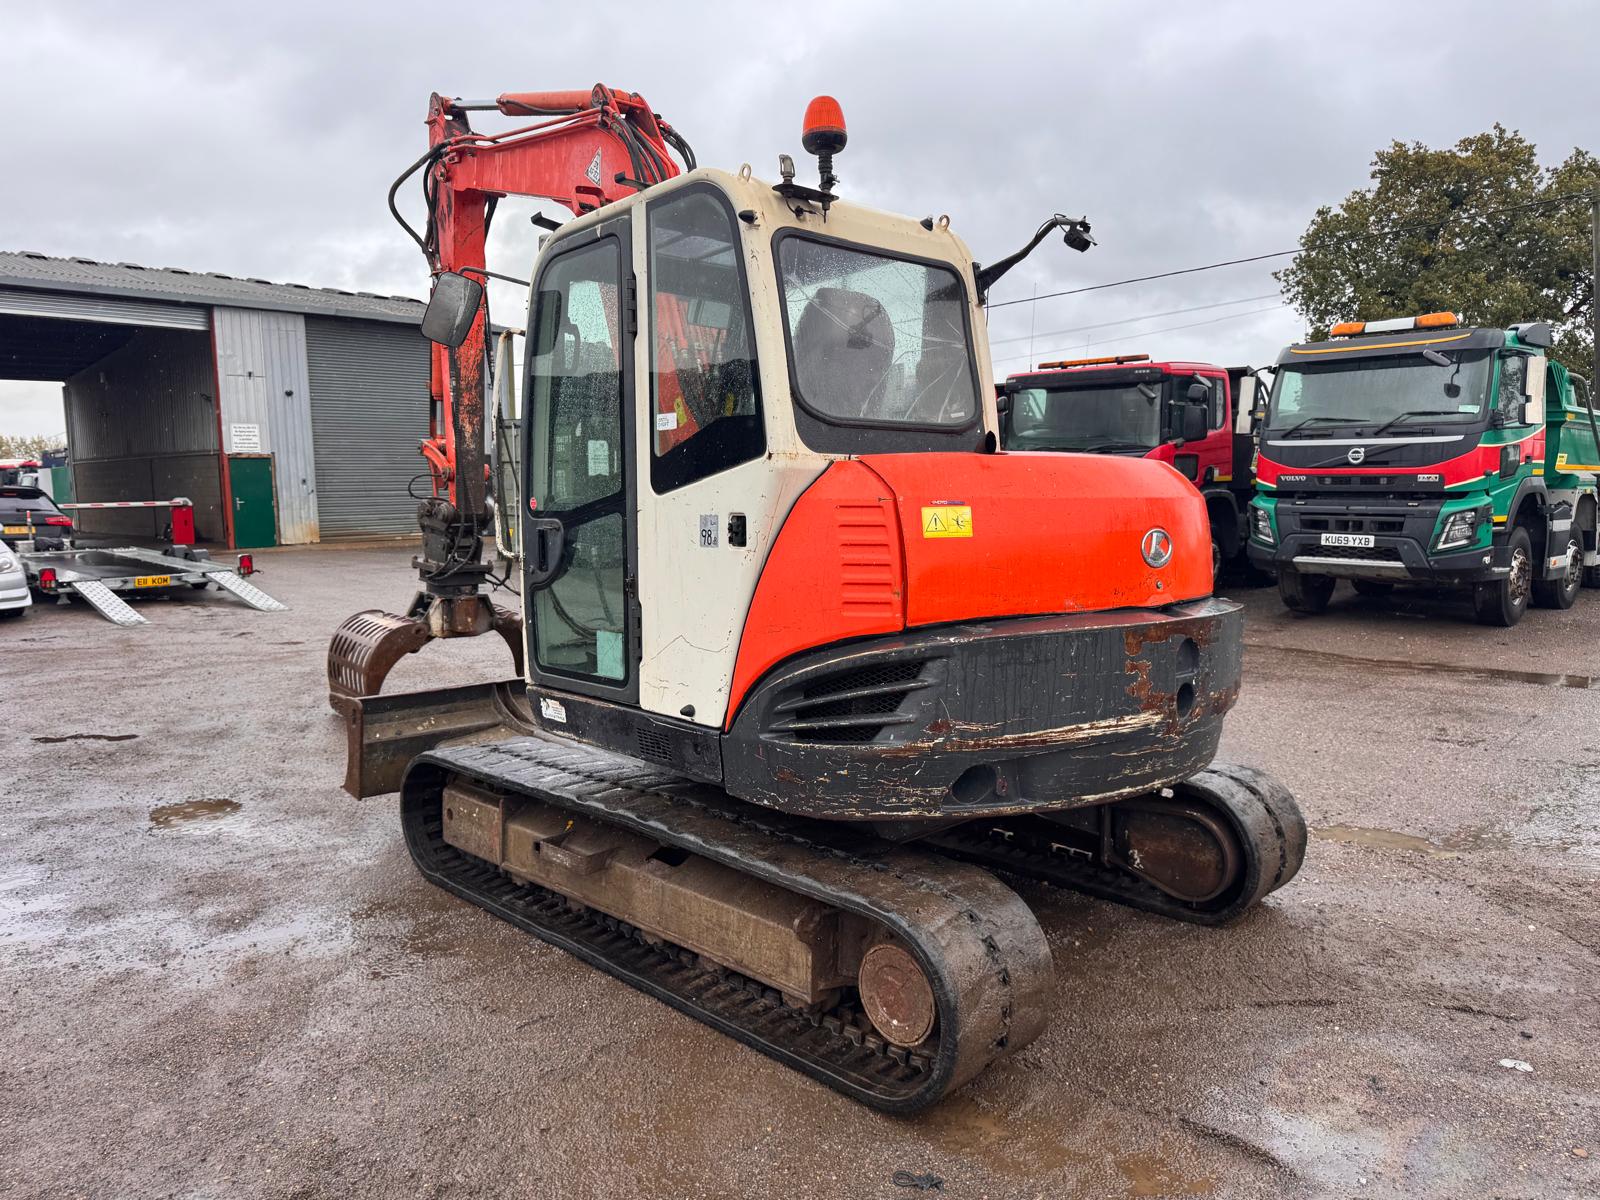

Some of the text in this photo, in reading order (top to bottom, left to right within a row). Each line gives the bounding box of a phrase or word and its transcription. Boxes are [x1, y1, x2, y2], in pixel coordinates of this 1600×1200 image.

[701, 529, 712, 545] 98
[1325, 536, 1370, 546] KU69 YXB
